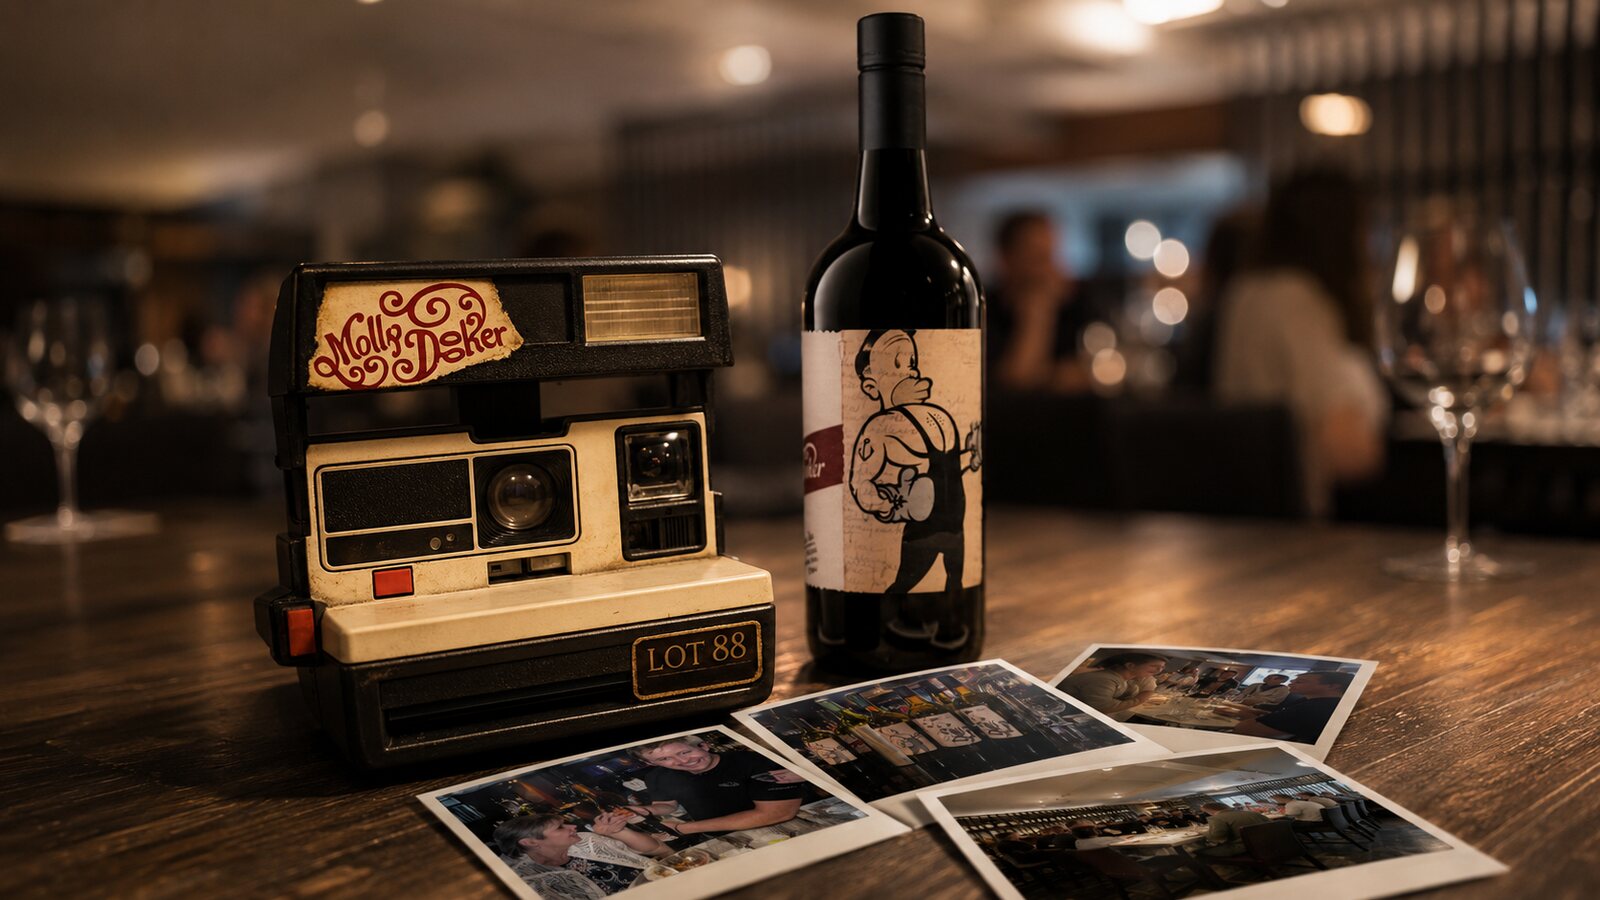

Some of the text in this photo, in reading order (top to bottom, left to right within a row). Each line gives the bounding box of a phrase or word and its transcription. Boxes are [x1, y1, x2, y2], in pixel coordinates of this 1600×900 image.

[314, 312, 402, 380] Molly
[647, 631, 747, 672] LOT 88
